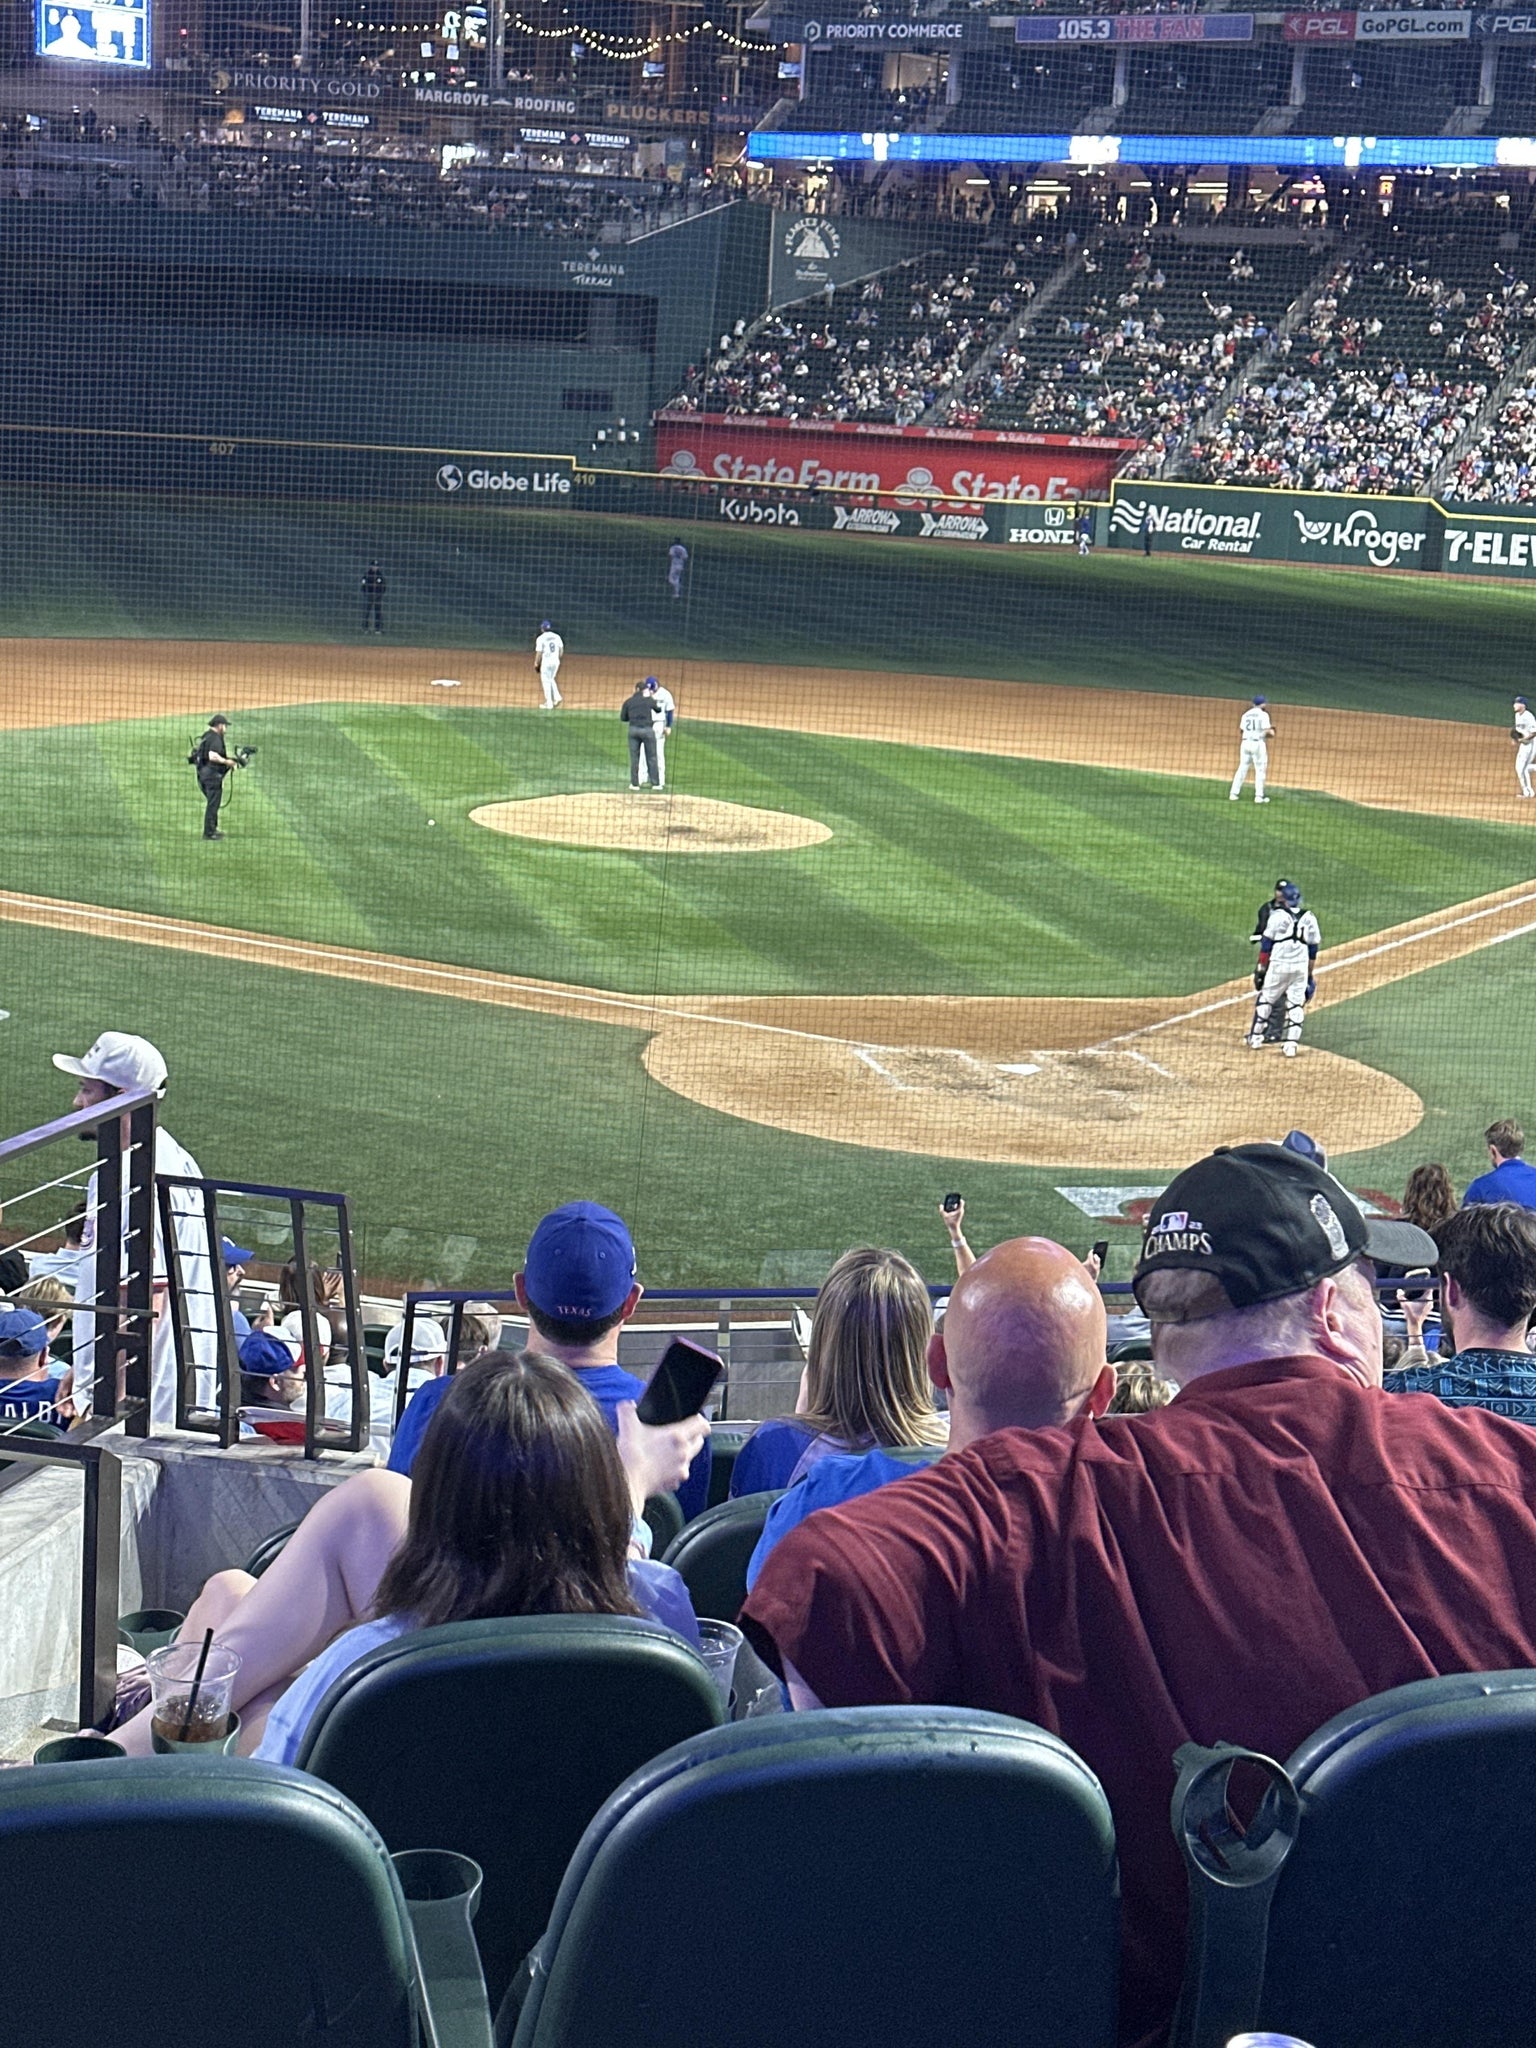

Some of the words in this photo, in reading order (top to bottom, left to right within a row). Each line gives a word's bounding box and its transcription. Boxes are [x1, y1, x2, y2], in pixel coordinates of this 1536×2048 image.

[826, 24, 886, 39] PRIORITY
[888, 24, 963, 38] COMMERCE
[1057, 20, 1111, 39] 105.3
[1114, 19, 1155, 40] THE
[1159, 17, 1206, 39] FAN
[1304, 18, 1349, 35] PGL
[1362, 18, 1464, 33] GoPGL.com
[233, 72, 321, 93] PRIORITY
[327, 80, 380, 98] GOLD
[415, 88, 489, 107] HARGROVE
[515, 97, 576, 114] ROOFING
[254, 106, 303, 119] TEREMANA
[322, 112, 370, 124] TEREMANA
[607, 104, 710, 125] PLUCKERS
[561, 261, 625, 275] TEREMANA
[209, 442, 235, 455] 407
[467, 470, 529, 491] Globe
[533, 472, 571, 493] Life
[573, 473, 596, 486] 410
[720, 498, 800, 525] Kubota
[849, 507, 892, 525] ARROW
[935, 514, 979, 531] ARROW
[1147, 504, 1261, 539] National
[1009, 528, 1075, 544] HOND
[1181, 536, 1205, 549] Car
[1207, 538, 1253, 553] Rental
[1332, 509, 1426, 567] Kroger
[1444, 529, 1536, 567] 7-ELE
[1144, 1232, 1213, 1259] CHAMPS
[557, 1306, 592, 1317] TEXAS
